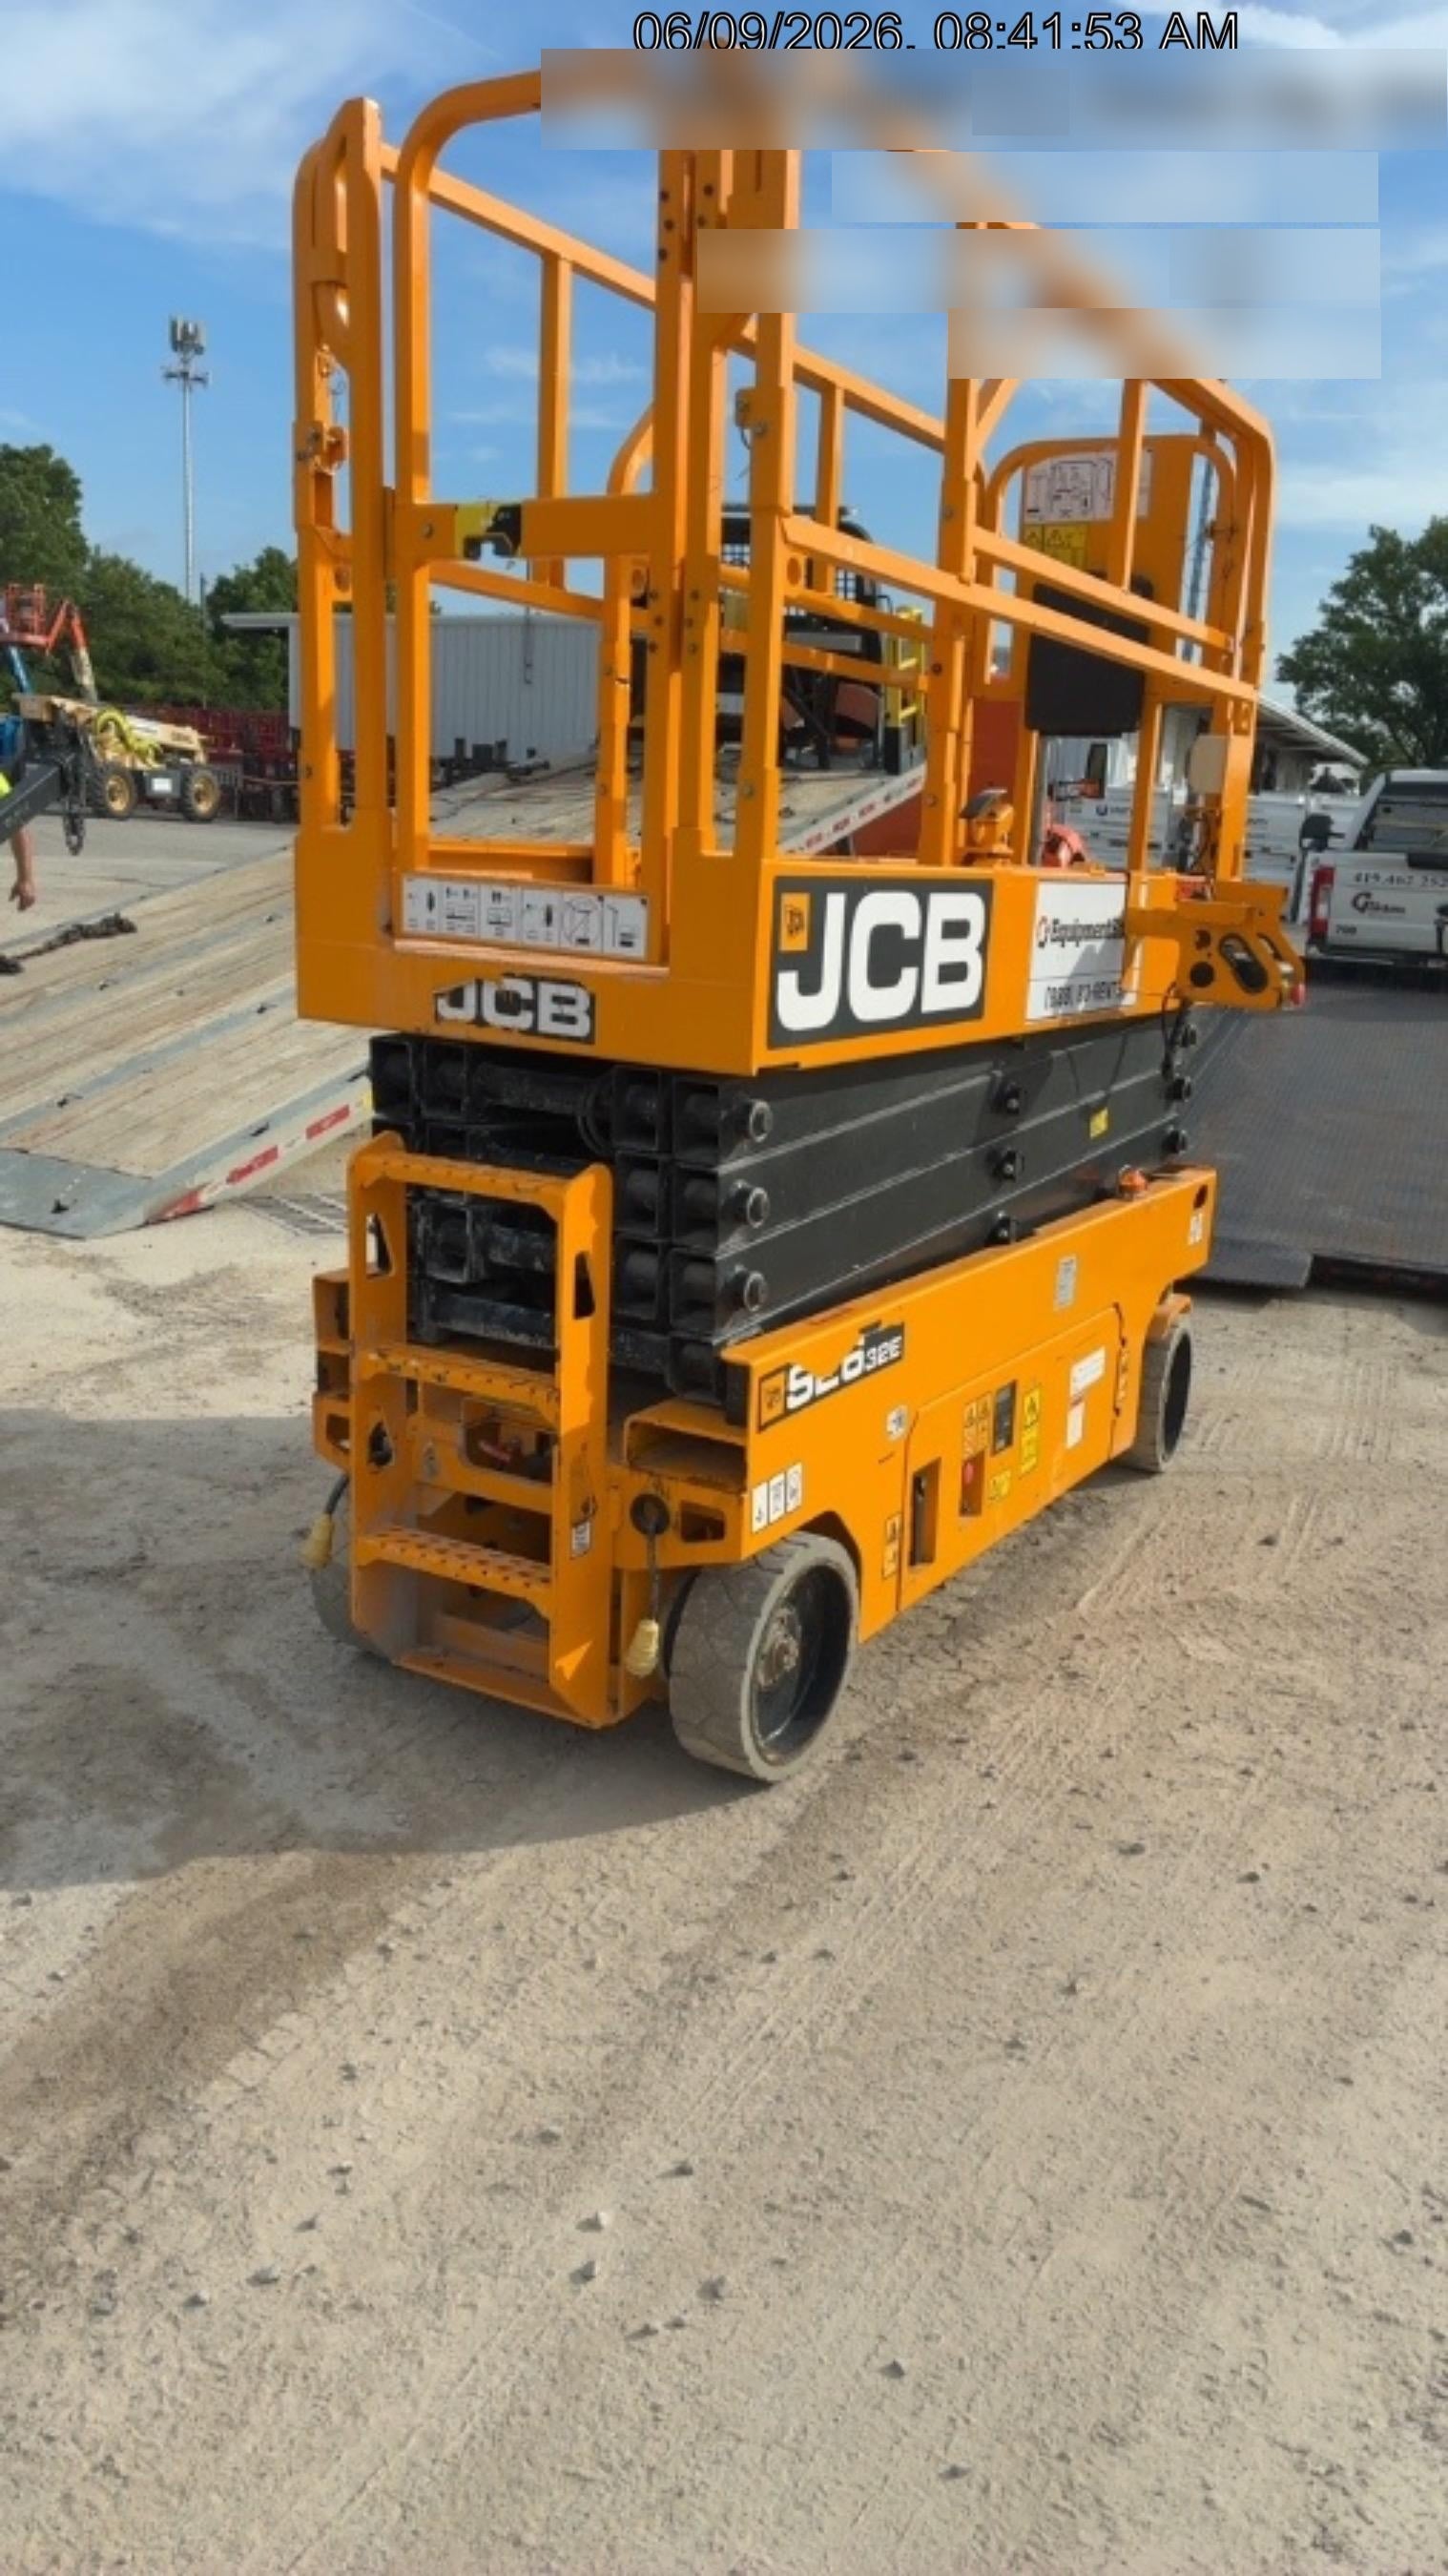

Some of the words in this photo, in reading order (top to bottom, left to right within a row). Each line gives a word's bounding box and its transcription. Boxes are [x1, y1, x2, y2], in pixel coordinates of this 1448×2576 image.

[776, 890, 986, 1031] JCB
[1050, 918, 1124, 947] EquipmentS
[436, 974, 591, 1038] JCB
